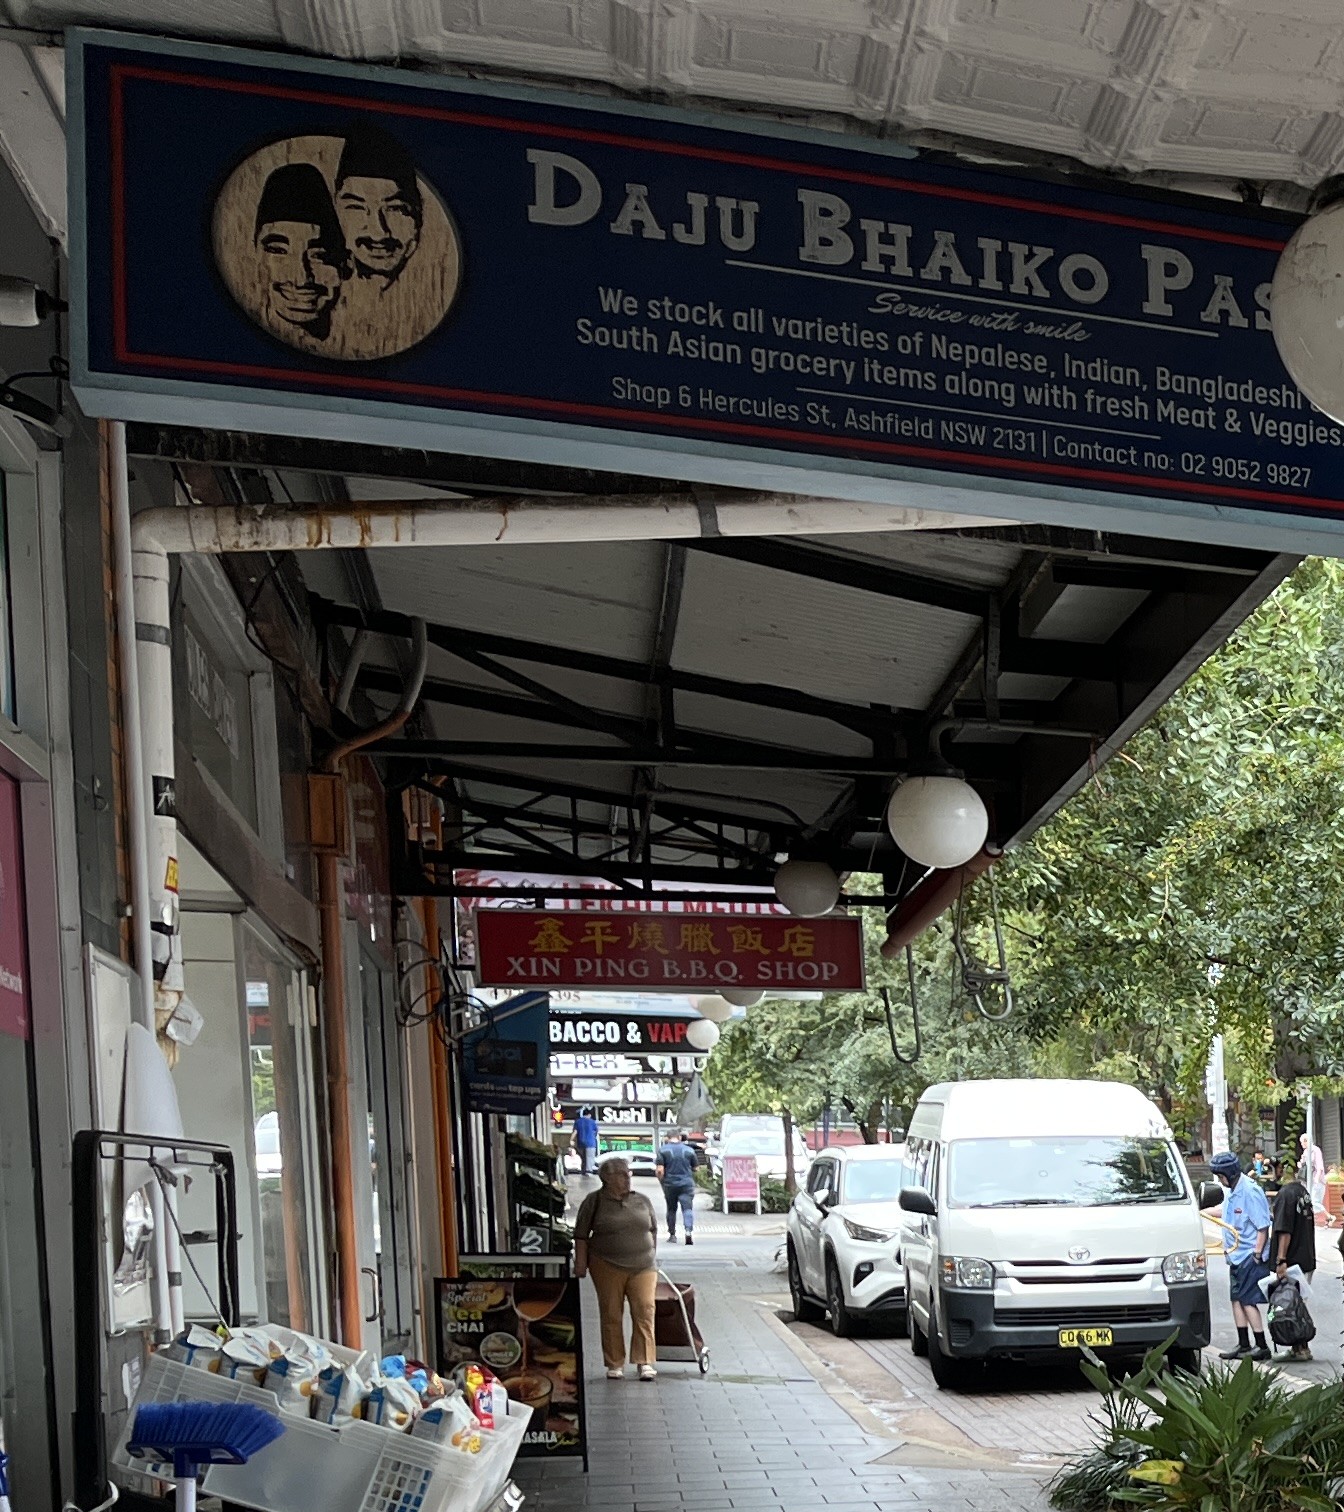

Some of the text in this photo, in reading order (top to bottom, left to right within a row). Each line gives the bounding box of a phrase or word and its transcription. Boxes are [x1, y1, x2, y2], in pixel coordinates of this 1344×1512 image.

[526, 148, 759, 251] DAJU
[797, 188, 1108, 304] BHAIKO
[867, 292, 1091, 341] Service with smile
[599, 286, 1302, 410] We stock all varieties of Nepalese, Indian, Bangladeshi
[576, 318, 658, 353] South
[667, 331, 742, 365] Asian
[751, 347, 855, 385] grocery
[864, 357, 937, 391] items
[945, 371, 1015, 408] along
[1024, 383, 1076, 411] with
[1085, 389, 1148, 421] fresh
[1156, 399, 1216, 430] Meat
[1224, 409, 1241, 433] &
[612, 377, 670, 408] Shop
[678, 385, 692, 407] 6
[699, 389, 799, 421] Hercules
[845, 408, 933, 439] Ashfield
[940, 420, 987, 446] NSW
[993, 428, 1035, 454] 2131
[1054, 436, 1137, 466] Contact
[1144, 453, 1175, 471] no:
[1181, 453, 1206, 475] 02
[1212, 457, 1261, 482] 9052
[1267, 464, 1311, 488] 9827
[507, 957, 839, 982] XIN PING B.B.Q. SHOP
[549, 1020, 688, 1044] BACCO & VAP
[602, 1107, 647, 1123] Sushi
[446, 1321, 485, 1333] CHAI
[522, 1431, 558, 1443] ASALA
